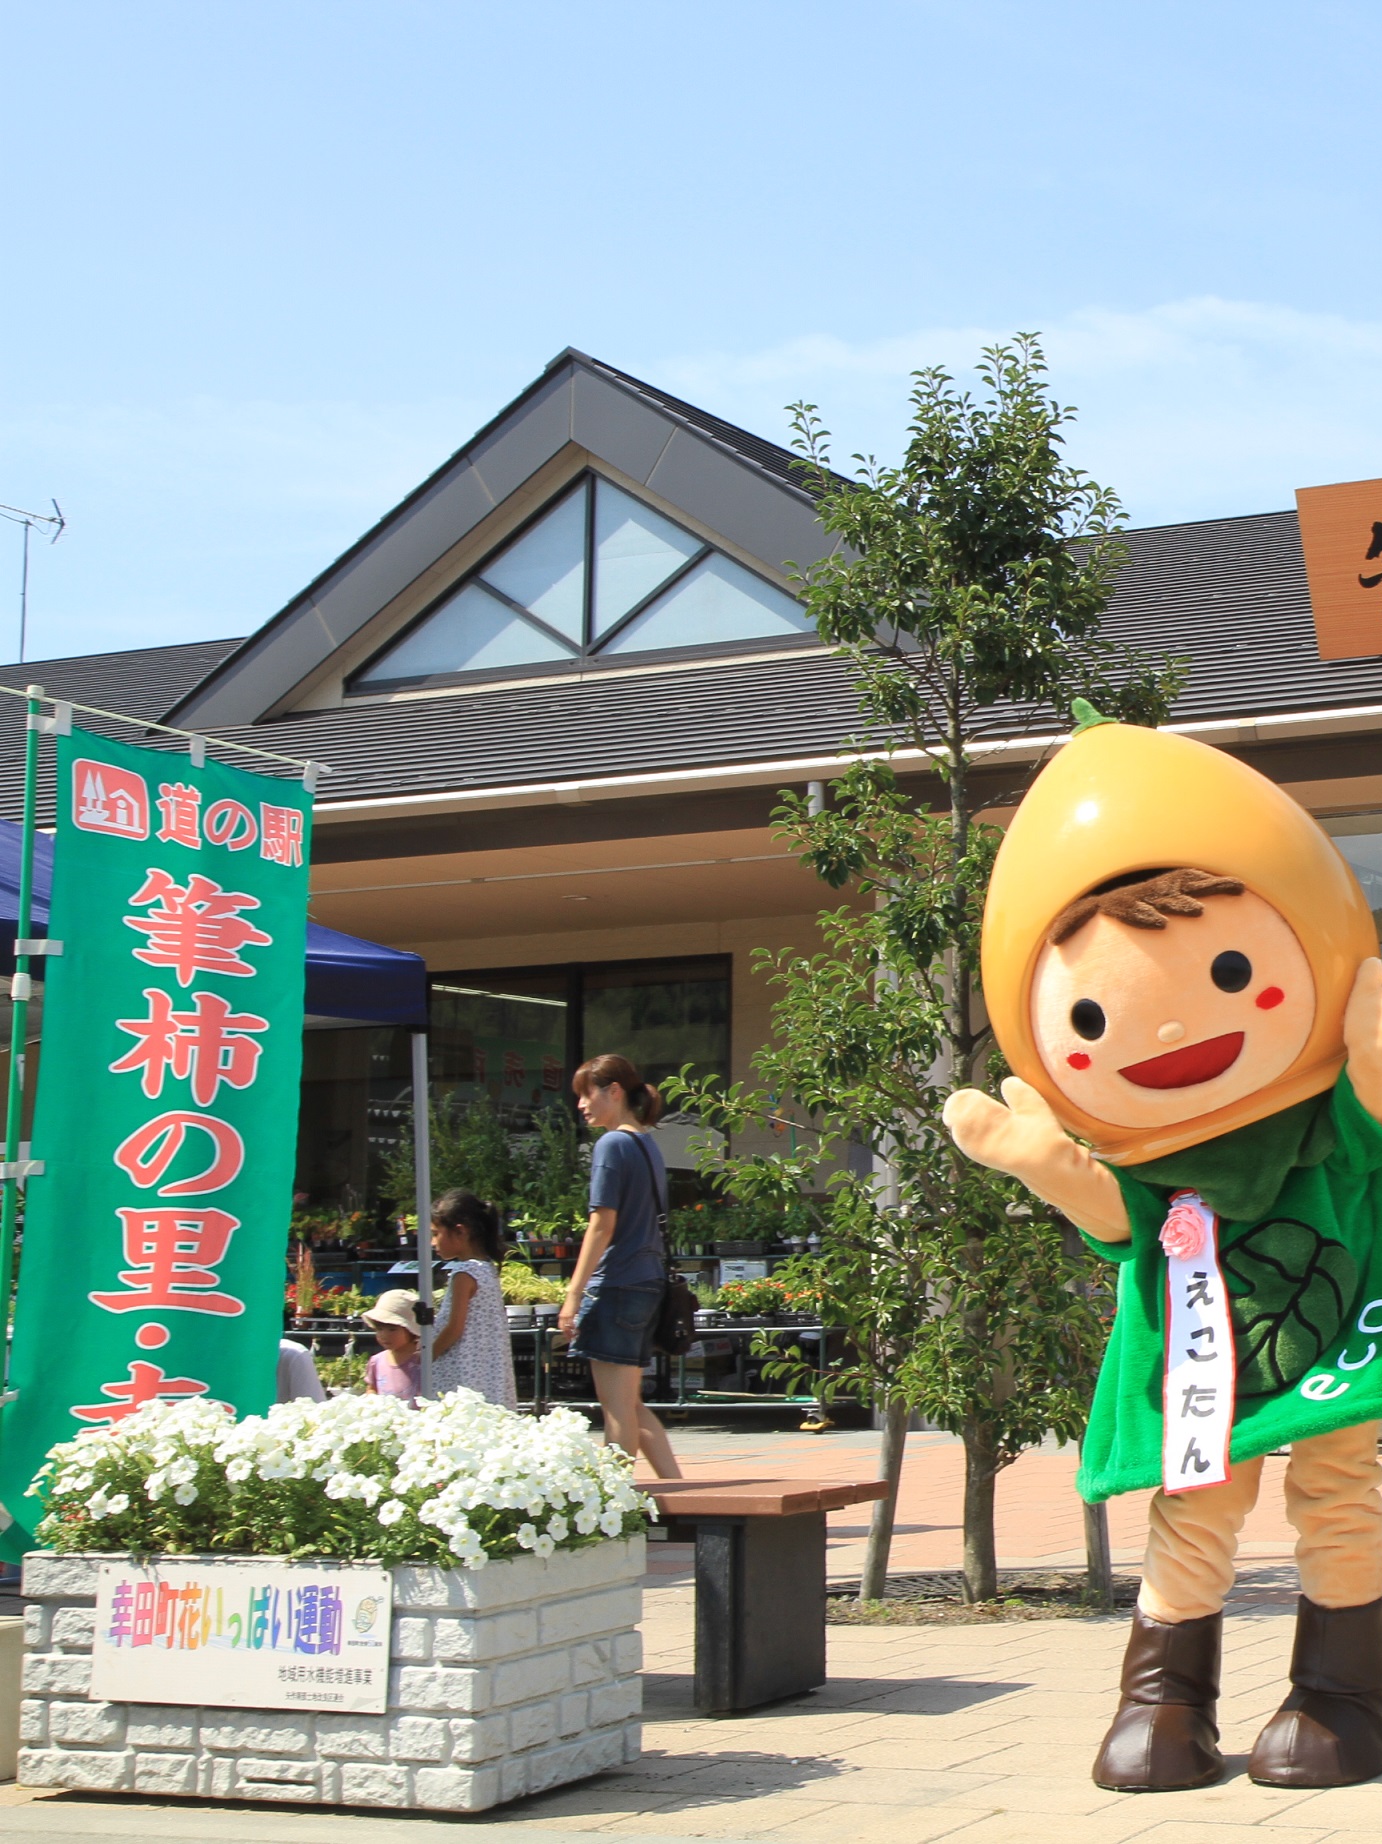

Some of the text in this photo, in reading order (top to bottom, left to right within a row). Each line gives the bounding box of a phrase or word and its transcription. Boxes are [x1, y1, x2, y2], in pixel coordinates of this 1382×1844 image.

[155, 782, 303, 867] 道の駅
[1180, 1271, 1218, 1474] えこたん
[109, 1579, 343, 1656] 幸田町花いっぱい運動
